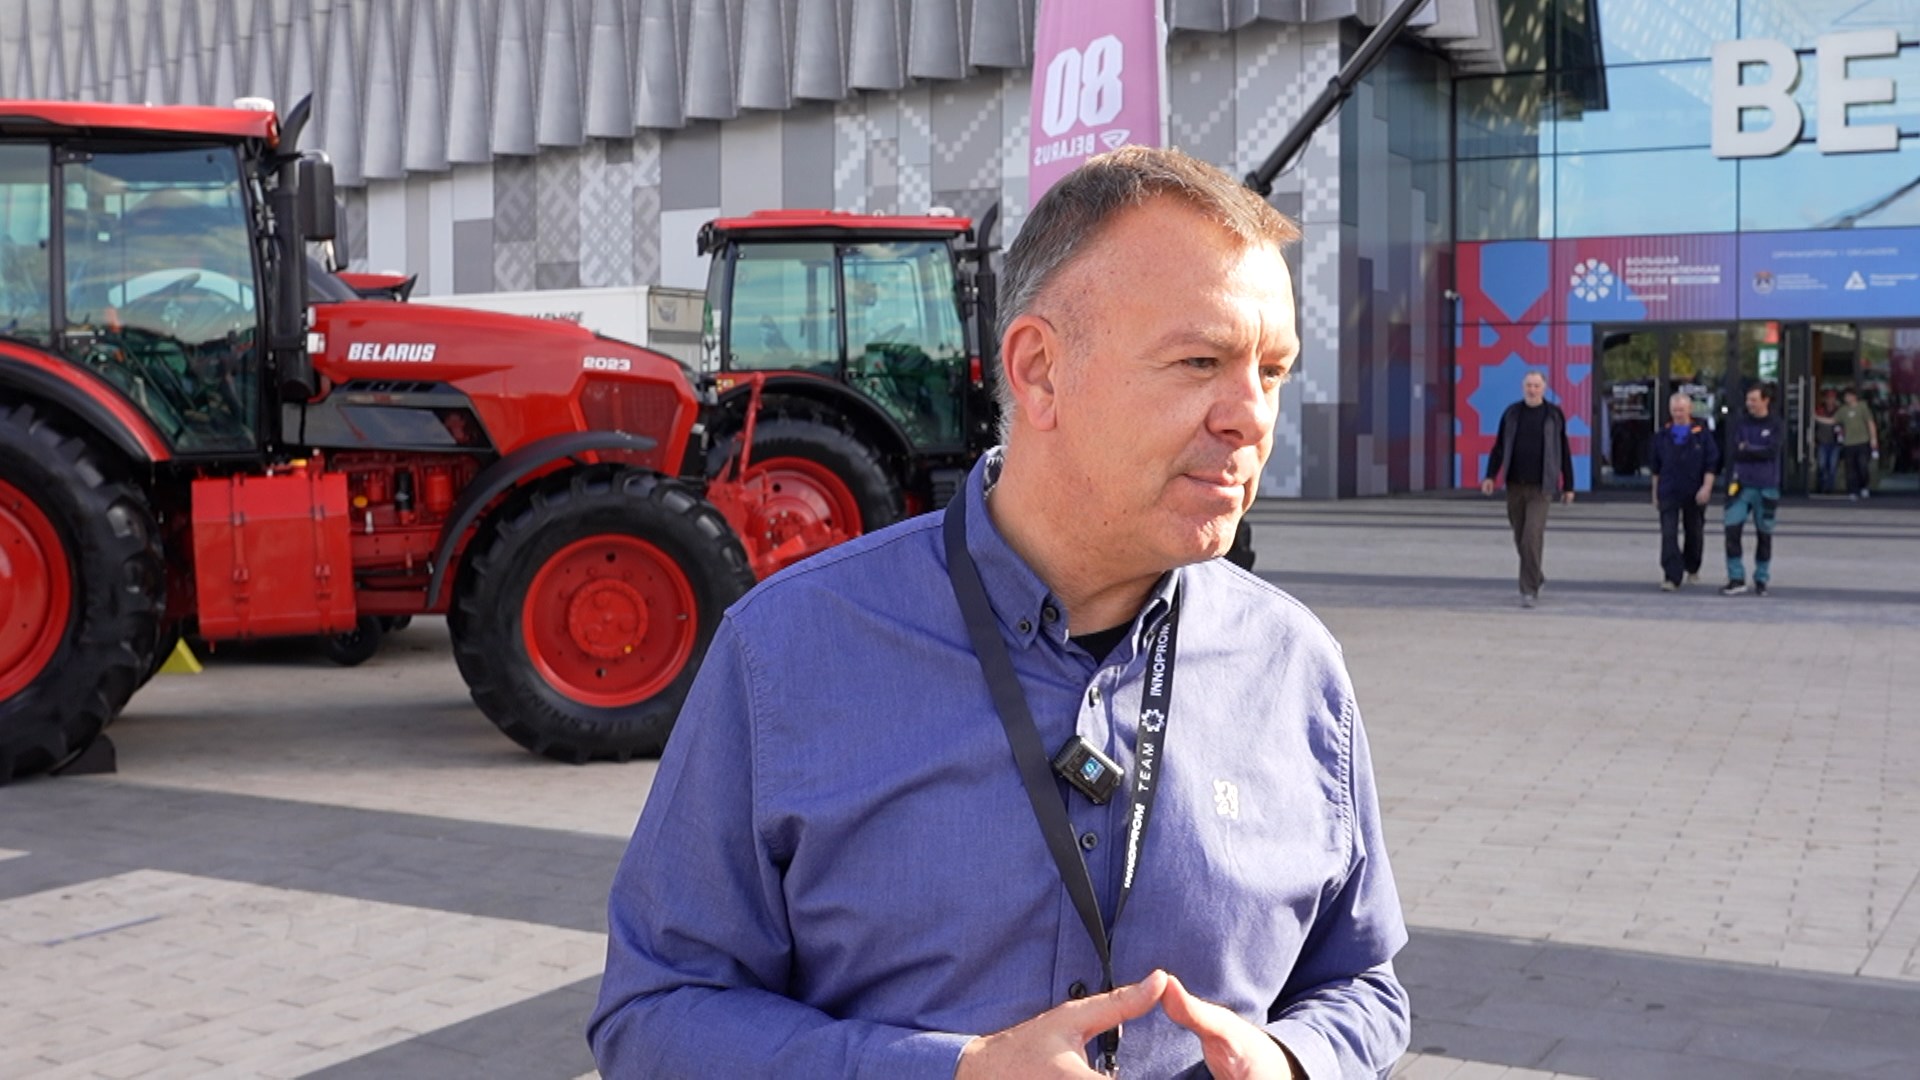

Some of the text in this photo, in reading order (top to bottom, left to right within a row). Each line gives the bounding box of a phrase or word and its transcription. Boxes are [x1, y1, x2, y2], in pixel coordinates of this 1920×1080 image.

[1712, 30, 1901, 159] BE
[347, 342, 436, 362] BELARUS
[583, 356, 631, 371] 2023
[1138, 742, 1155, 791] TEAM
[1150, 623, 1171, 696] INNOPROM
